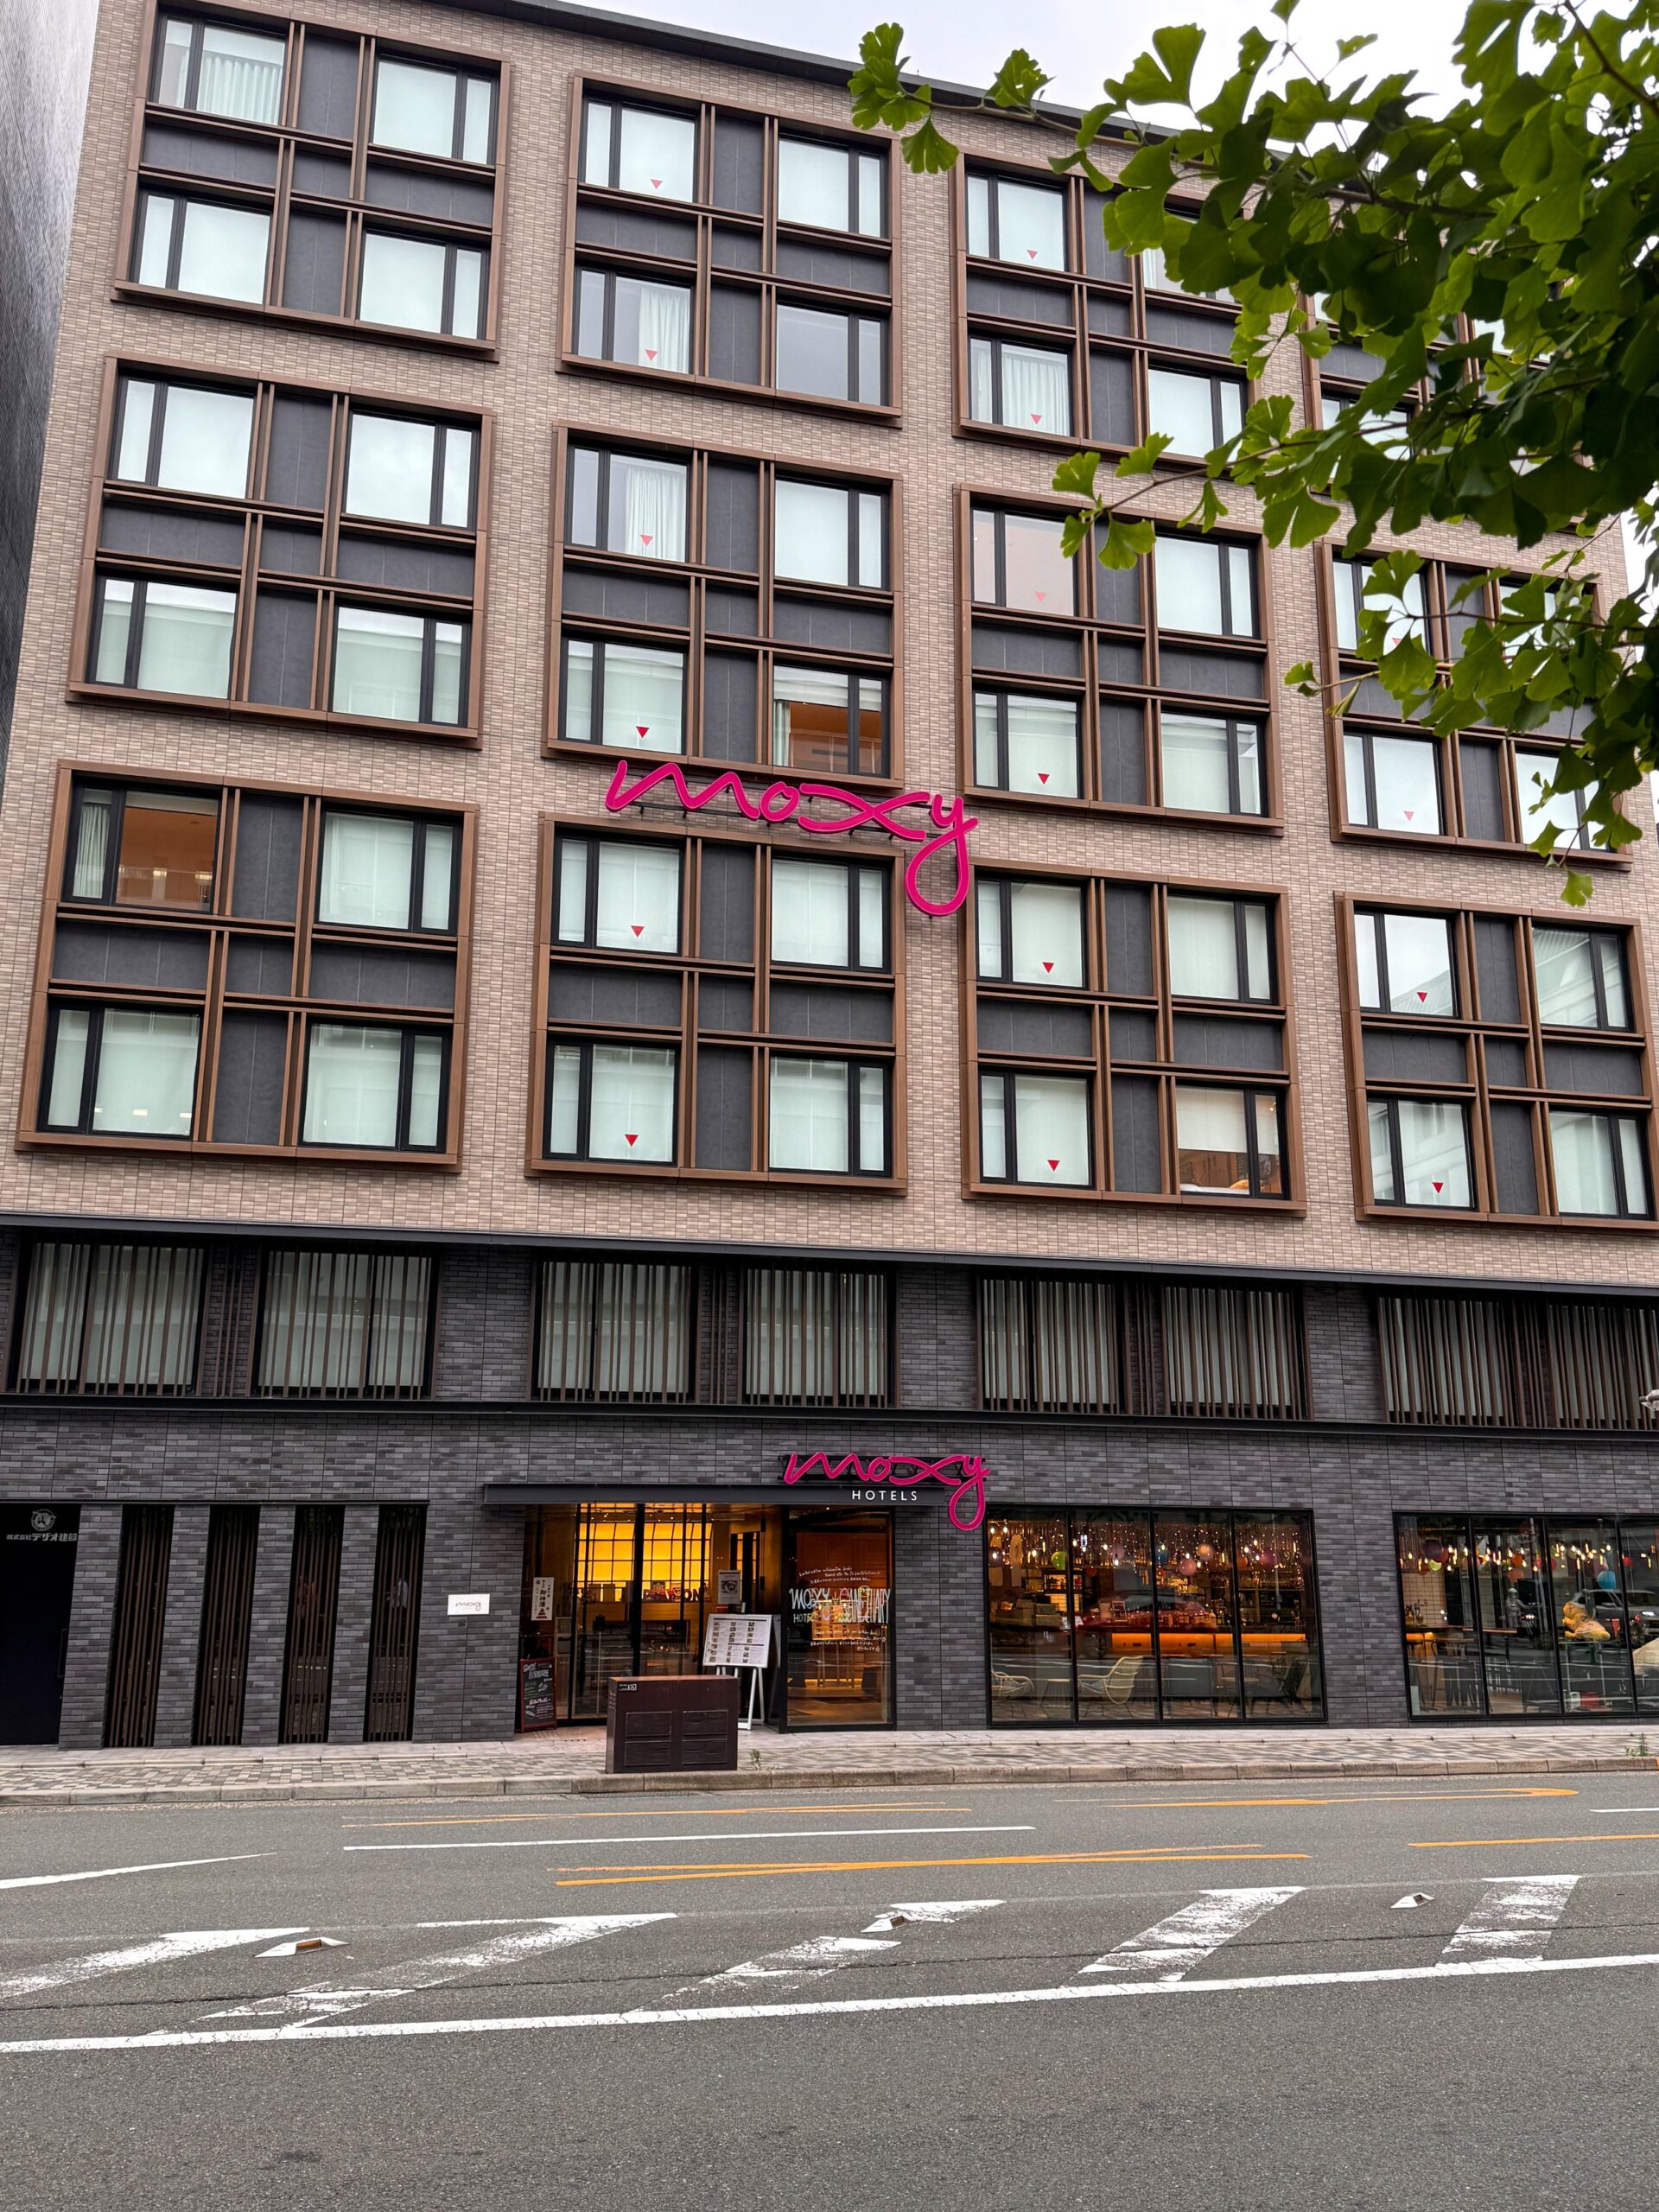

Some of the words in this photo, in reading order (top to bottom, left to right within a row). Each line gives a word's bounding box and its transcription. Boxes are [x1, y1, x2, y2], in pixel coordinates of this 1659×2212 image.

[606, 760, 978, 917] moxy
[784, 1452, 990, 1531] moxy
[851, 1490, 918, 1502] HOTELS
